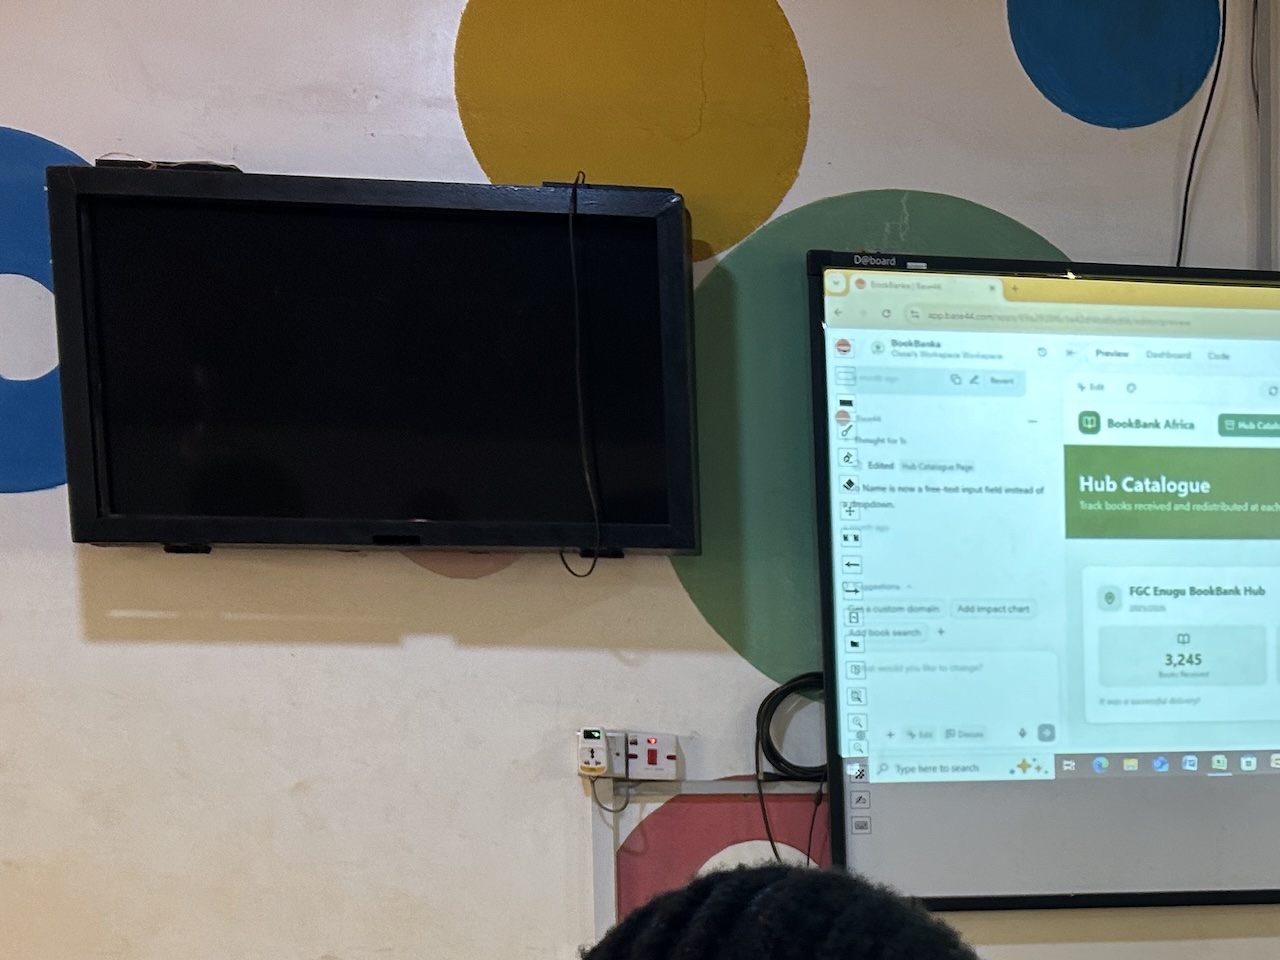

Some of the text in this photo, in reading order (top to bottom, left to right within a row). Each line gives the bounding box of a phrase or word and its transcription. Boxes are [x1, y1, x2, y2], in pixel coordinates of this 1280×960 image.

[854, 255, 896, 266] D@board
[1096, 349, 1230, 361] Preview Dashboard Code
[990, 377, 1014, 385] Revert
[1090, 383, 1105, 392] Edit
[1107, 418, 1195, 431] BookBank Africa
[1238, 421, 1253, 431] Hub
[868, 461, 974, 473] Edited Hub Catalogue Page
[889, 485, 896, 493] is
[925, 485, 959, 494] free-text
[961, 486, 983, 496] input
[984, 486, 1002, 494] field
[1004, 486, 1034, 494] instead
[1036, 487, 1044, 495] of
[1079, 474, 1211, 498] Hub Catalogue
[1080, 501, 1103, 511] Track
[1105, 501, 1132, 511] books
[1134, 502, 1171, 512] received
[1173, 502, 1190, 511] and
[1192, 502, 1248, 512] redistributed
[1250, 503, 1259, 512] at
[1261, 503, 1280, 512] each
[1129, 586, 1266, 598] FGC Enugu BookBank Hub
[873, 605, 905, 613] custom
[907, 605, 940, 613] domain
[957, 605, 1030, 615] Add impact chart
[892, 629, 922, 637] search
[1165, 653, 1203, 668] 3,245
[904, 665, 921, 674] you
[896, 763, 980, 774] Type here to search
